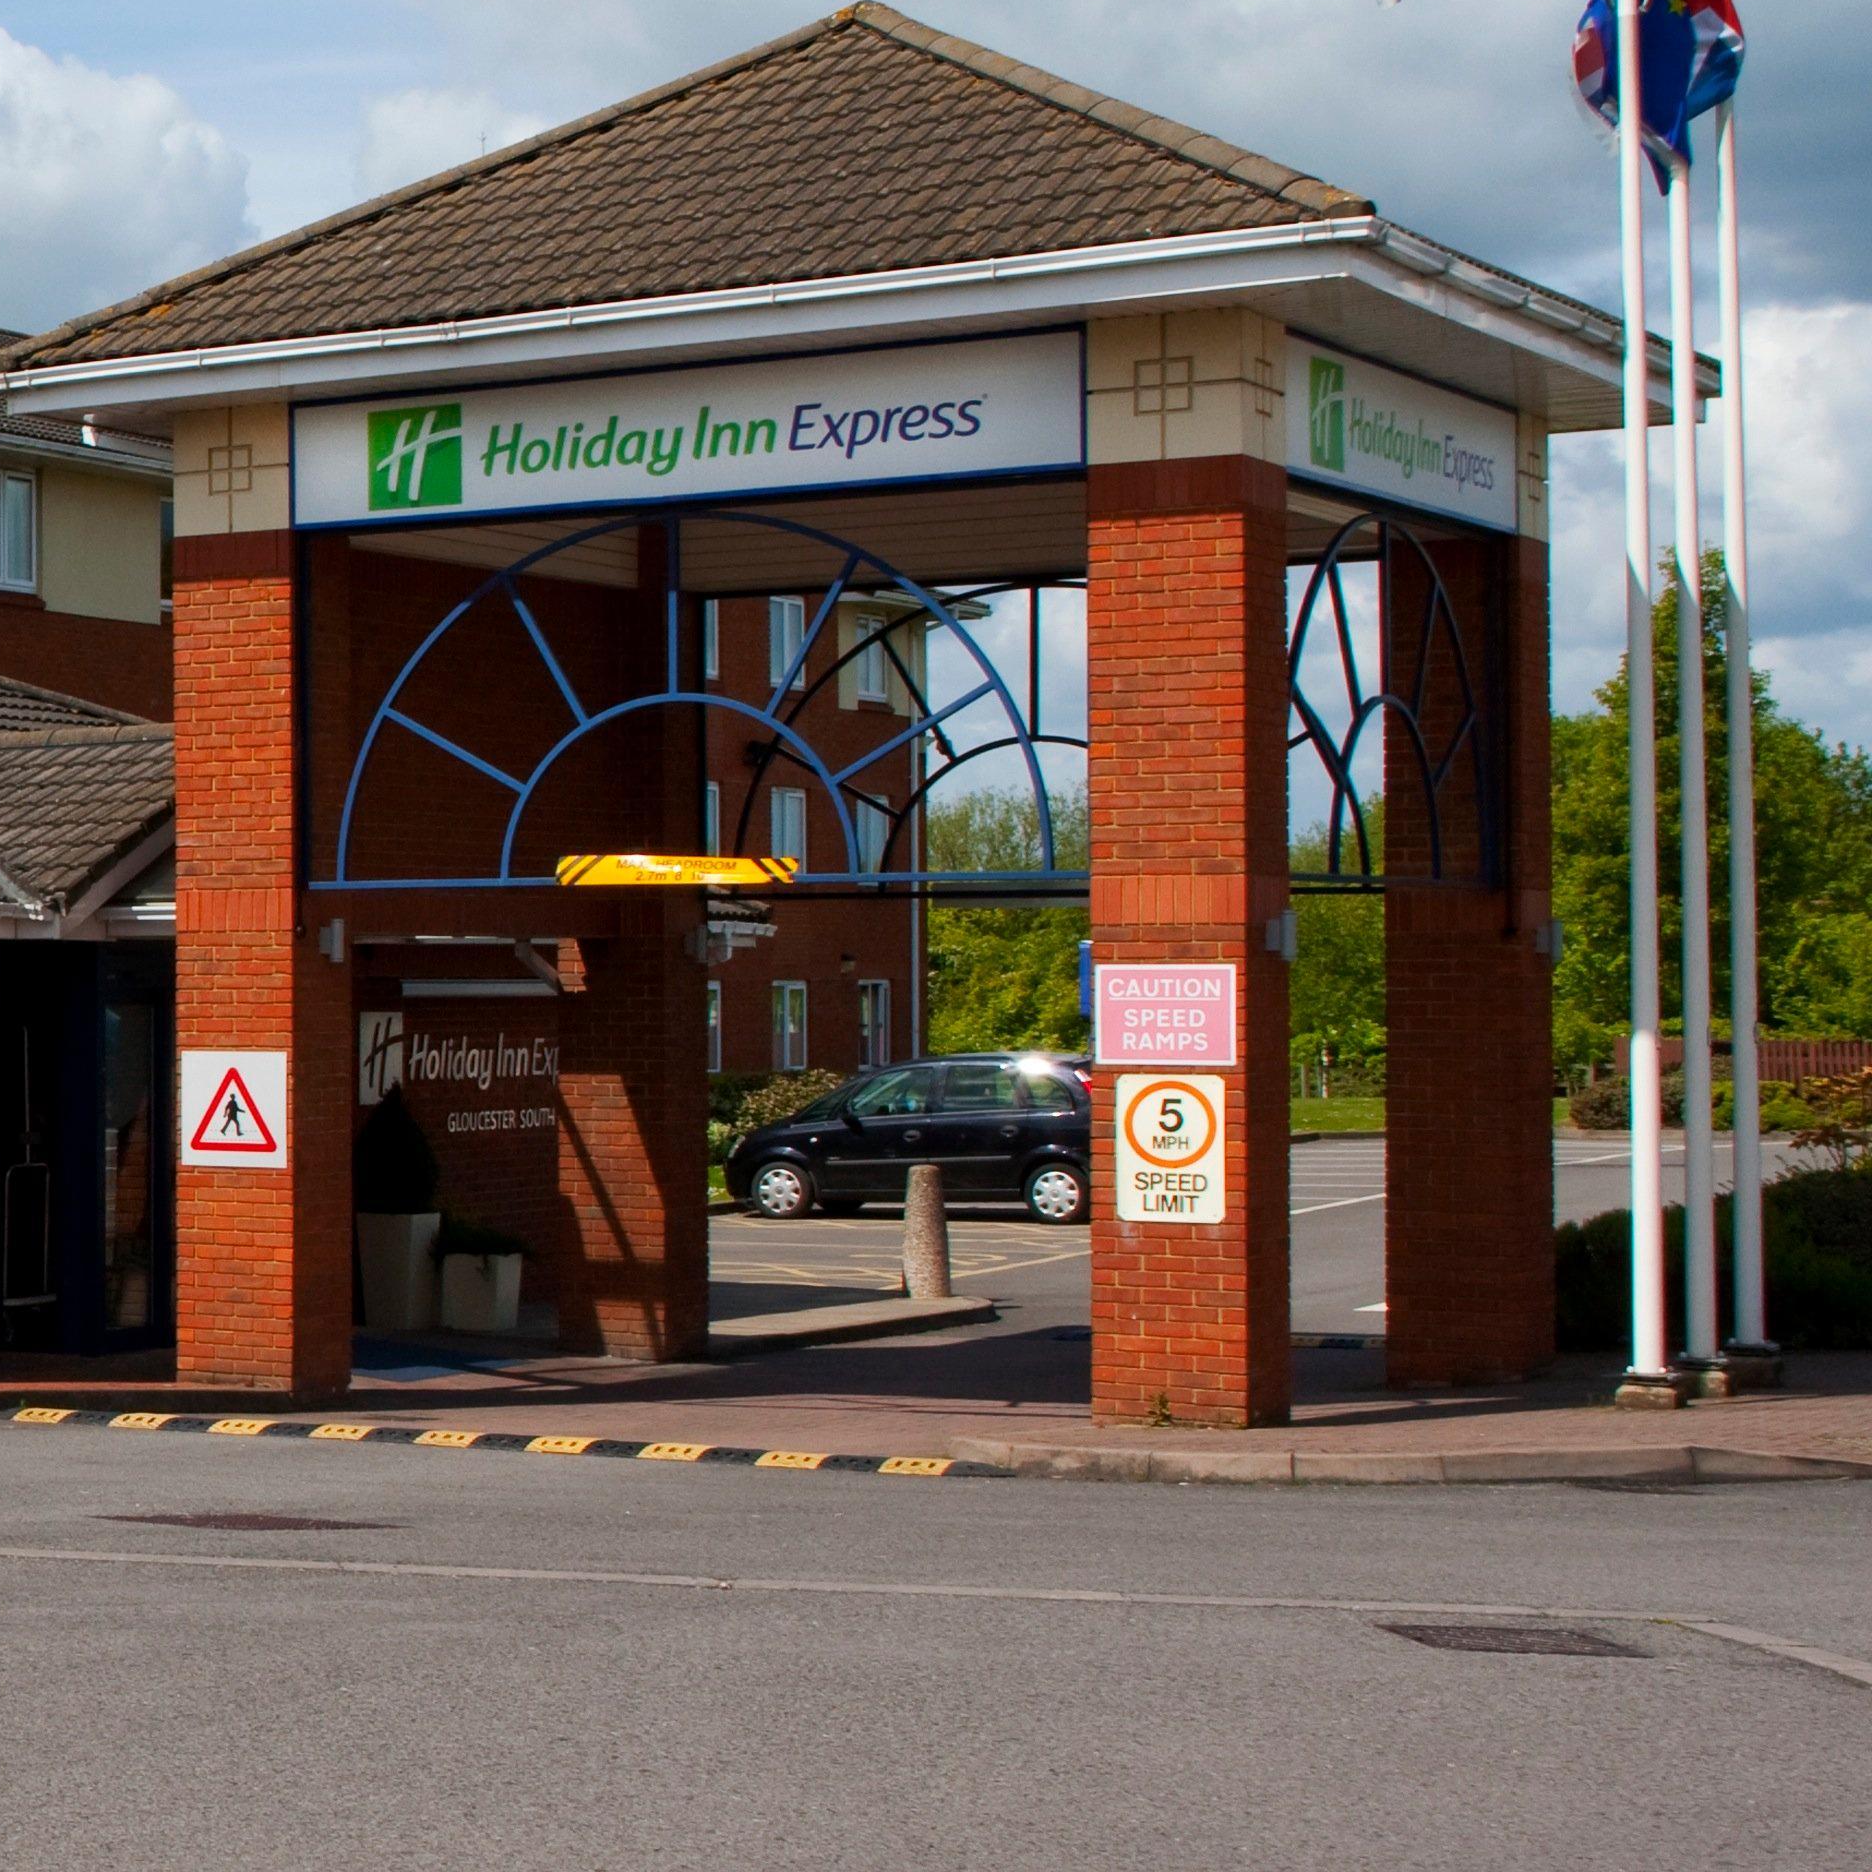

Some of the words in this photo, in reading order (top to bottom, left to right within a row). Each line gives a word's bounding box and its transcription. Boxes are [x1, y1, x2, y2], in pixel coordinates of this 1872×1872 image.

[480, 415, 684, 478] Holiday
[692, 406, 777, 460] Inn
[788, 399, 983, 459] Express
[1349, 397, 1416, 479] Holiday
[1416, 418, 1443, 474] Inn
[1443, 434, 1495, 493] Express
[656, 859, 737, 870] HEADROOM
[1107, 978, 1222, 997] CAUTION
[1123, 1008, 1206, 1028] SPEED
[1122, 1032, 1209, 1052] RAMPS
[408, 1033, 494, 1090] Holiday
[496, 1032, 528, 1078] Inn
[447, 1110, 516, 1133] GLOUCESTER
[519, 1108, 556, 1129] SOUTH
[1158, 1098, 1184, 1132] 5
[1152, 1135, 1190, 1149] MPH
[1134, 1172, 1208, 1192] SPEED
[1142, 1195, 1200, 1213] LIMIT
